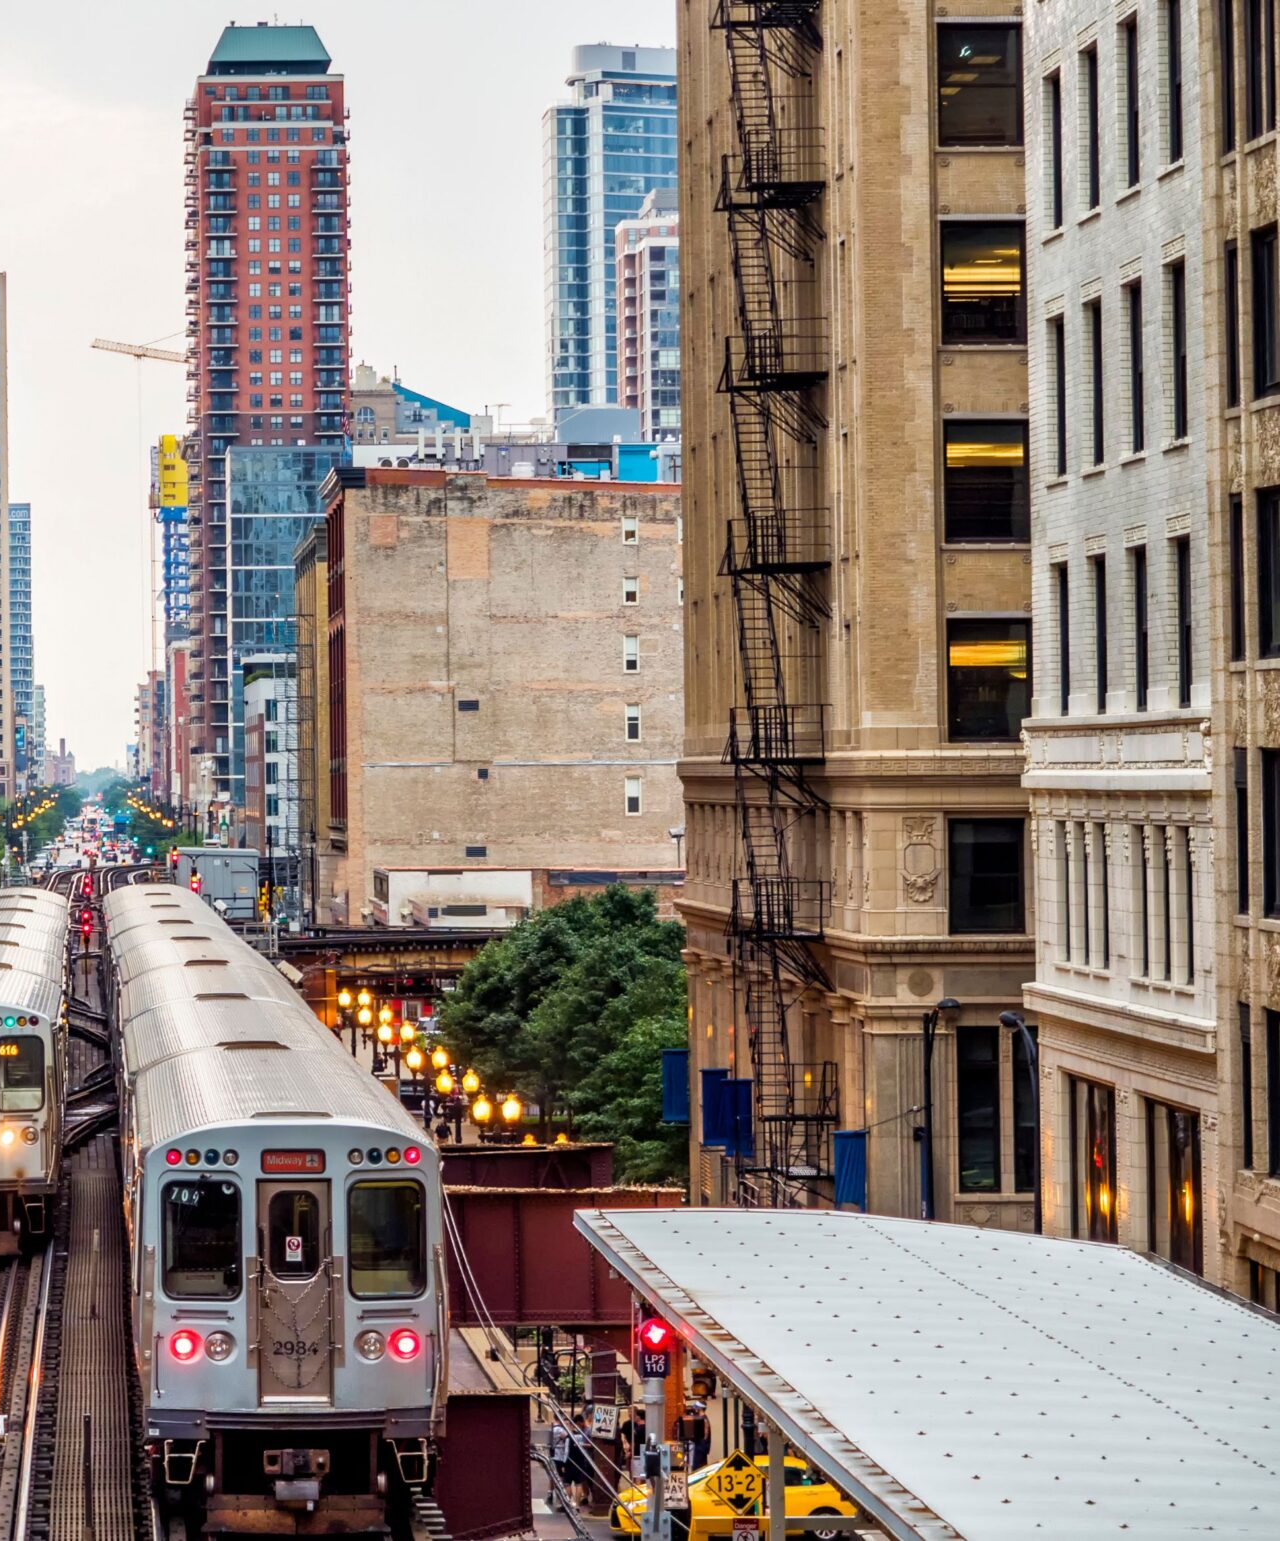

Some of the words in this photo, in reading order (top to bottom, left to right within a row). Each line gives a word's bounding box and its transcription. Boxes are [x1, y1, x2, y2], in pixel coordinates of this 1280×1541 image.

[0, 1044, 18, 1056] 616
[266, 1154, 303, 1166] Midway
[272, 1341, 319, 1355] 2984
[644, 1355, 665, 1364] LP2
[646, 1363, 665, 1373] 110
[596, 1406, 615, 1417] ONE
[734, 1522, 757, 1531] Danger
